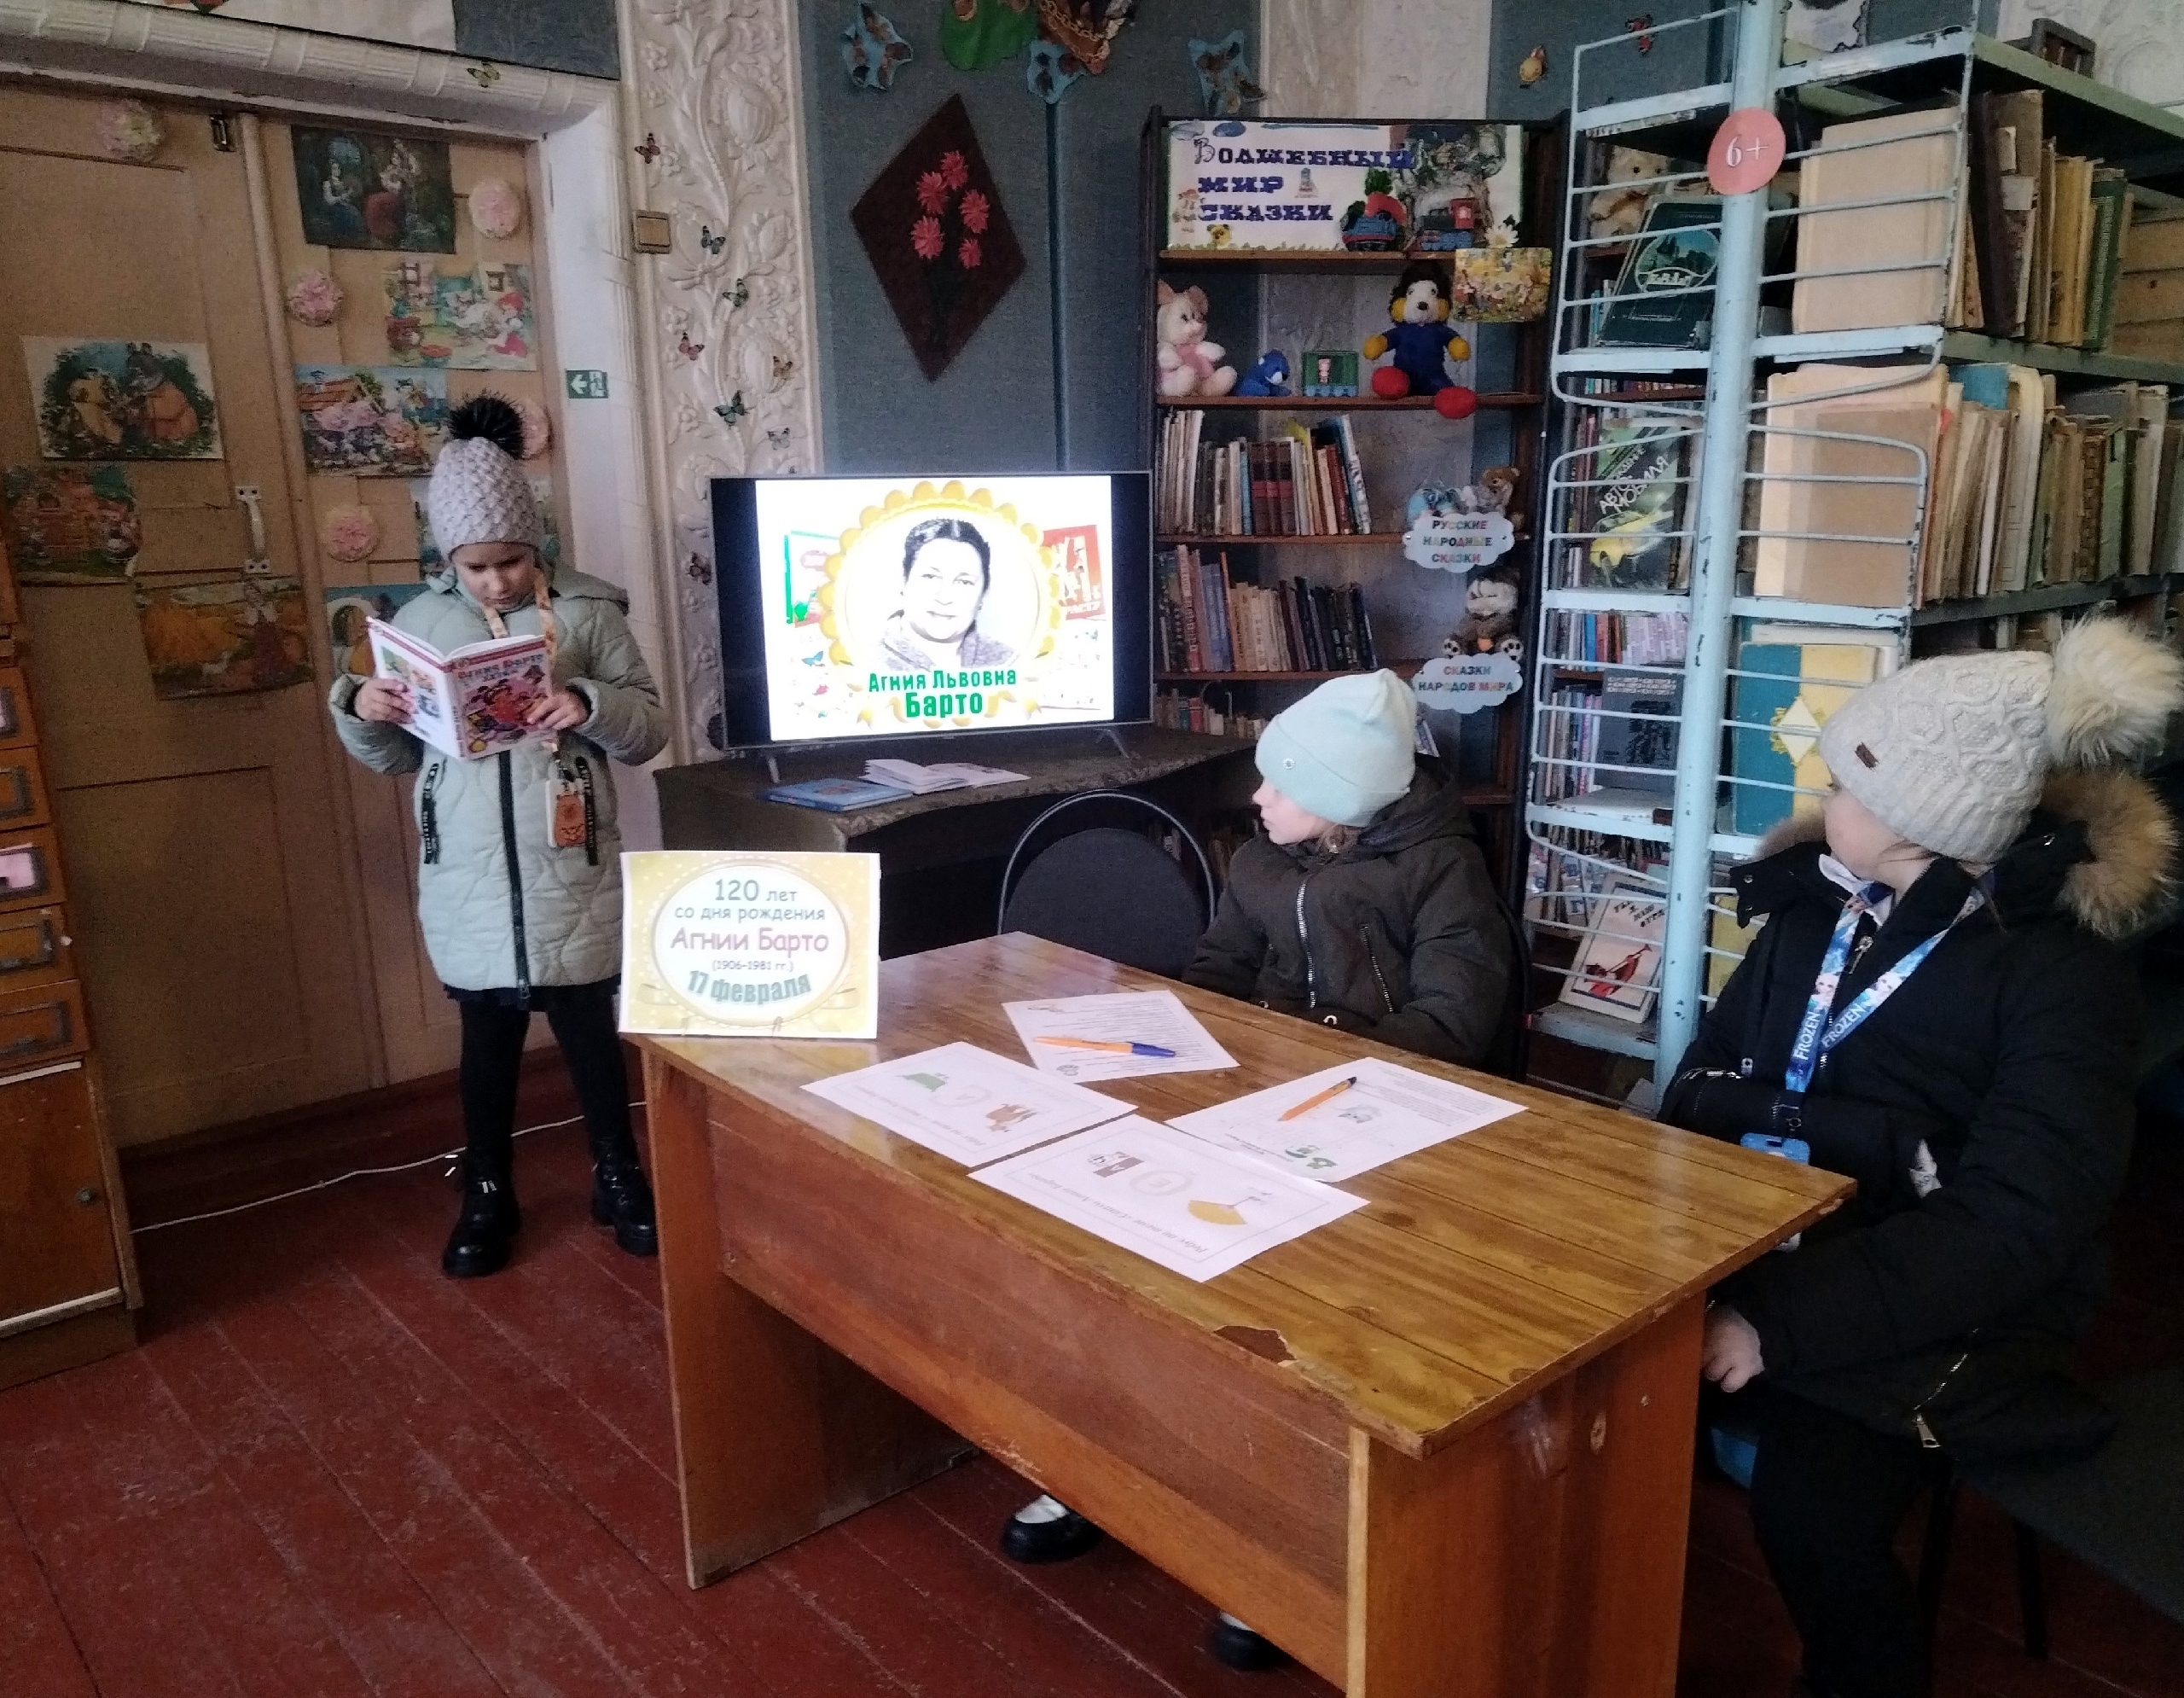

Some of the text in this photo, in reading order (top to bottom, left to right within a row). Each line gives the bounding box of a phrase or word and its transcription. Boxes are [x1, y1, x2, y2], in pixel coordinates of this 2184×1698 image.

[1725, 134, 1769, 167] 6+
[1198, 176, 1285, 193] МИР
[1198, 203, 1333, 222] СКАЗКИ
[1432, 520, 1487, 530] РУССКИЕ
[1422, 537, 1493, 547] НАРОДНЫЕ
[1432, 554, 1481, 563] СКАЗКИ
[868, 668, 1016, 692] Агния Львовна
[1443, 666, 1491, 675] СКАЗКИ
[1419, 682, 1513, 692] НАРОДОВ МИРА
[905, 691, 983, 718] Барто
[715, 879, 798, 902] 120 лет
[675, 906, 826, 924] со дня рождения
[670, 927, 829, 958] Агнии Барто
[687, 970, 812, 1005] 17 февраля
[1793, 1010, 1821, 1061] FROZEN
[1821, 1003, 1867, 1049] FROZEN
